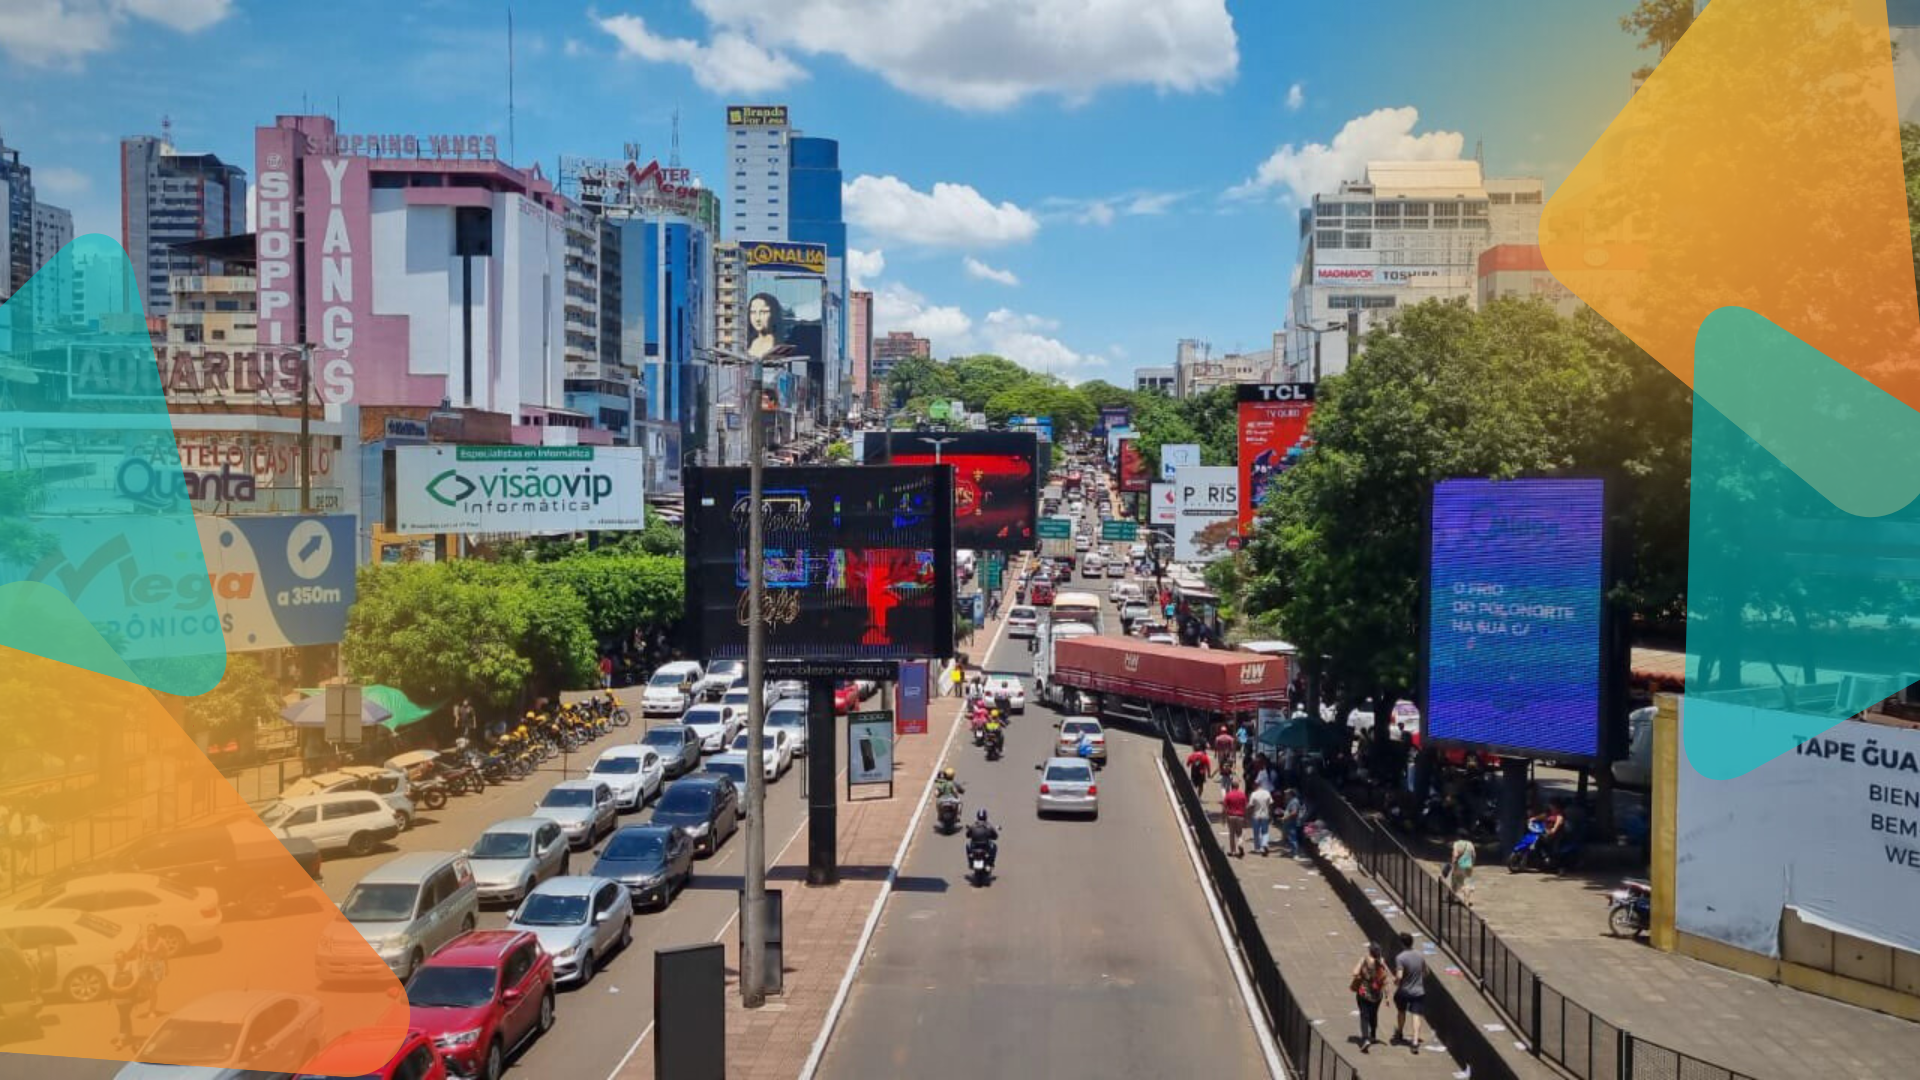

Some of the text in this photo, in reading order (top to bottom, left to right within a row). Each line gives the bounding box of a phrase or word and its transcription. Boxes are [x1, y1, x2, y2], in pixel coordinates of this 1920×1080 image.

[742, 106, 785, 118] Brands
[303, 134, 418, 155] SHOPPING
[321, 159, 355, 404] YANG'S
[1318, 269, 1374, 279] MAGNAVOX
[1259, 384, 1306, 400] TCL
[252, 445, 330, 476] CASTLO
[116, 457, 256, 502] Quanta
[479, 466, 612, 505] visãovip
[277, 587, 341, 606] a 350m
[1240, 663, 1266, 679] HW
[1792, 734, 1855, 763] TAPE
[1869, 784, 1920, 809] BIEN
